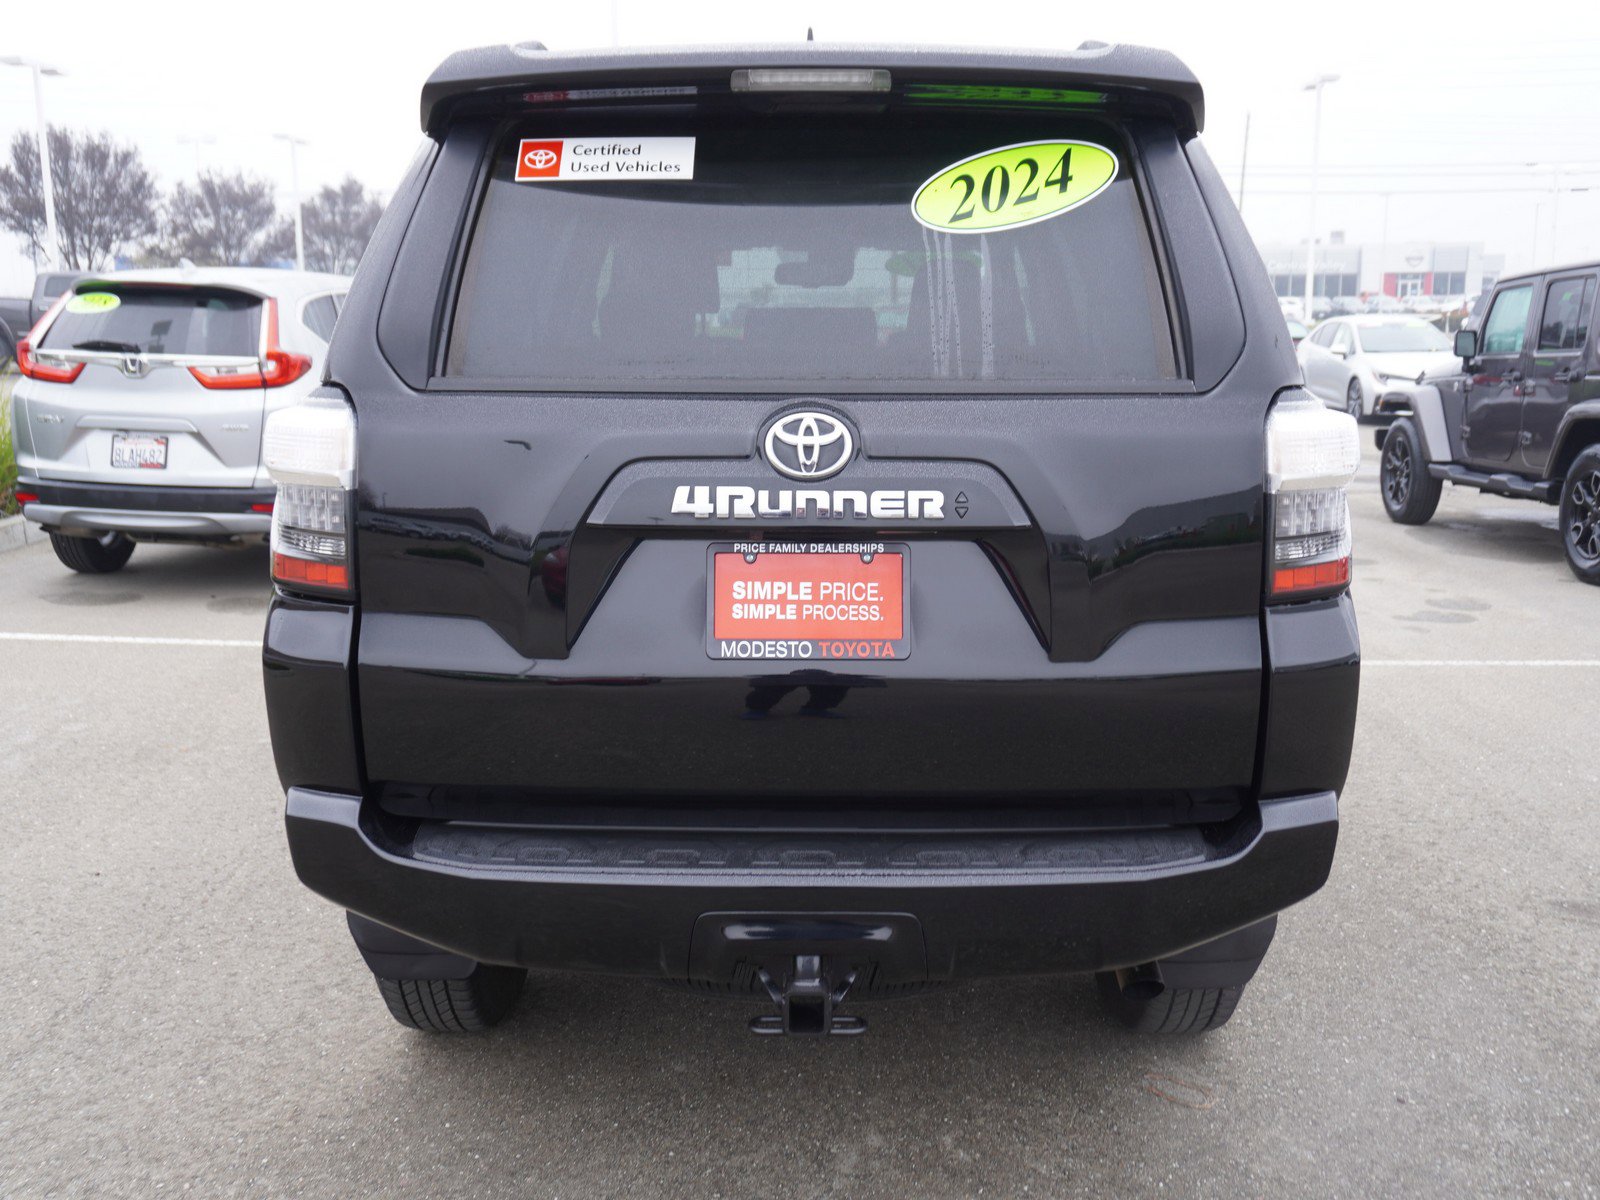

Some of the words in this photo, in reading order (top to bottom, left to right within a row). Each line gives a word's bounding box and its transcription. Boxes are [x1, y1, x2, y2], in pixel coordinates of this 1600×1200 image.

[573, 144, 641, 156] Certified
[570, 161, 610, 173] Used
[615, 161, 681, 173] Vehicles
[947, 147, 1073, 225] 2024
[733, 543, 766, 553] PRICE
[769, 543, 806, 553] FAMILY
[810, 543, 885, 553] DEALERSHIPS
[732, 581, 812, 601] SIMPLE
[819, 582, 884, 602] PRICE.
[731, 603, 797, 620] SIMPLE
[802, 604, 884, 621] PROCESS.
[720, 640, 813, 659] MODESTO
[818, 641, 896, 658] TOYOTA
